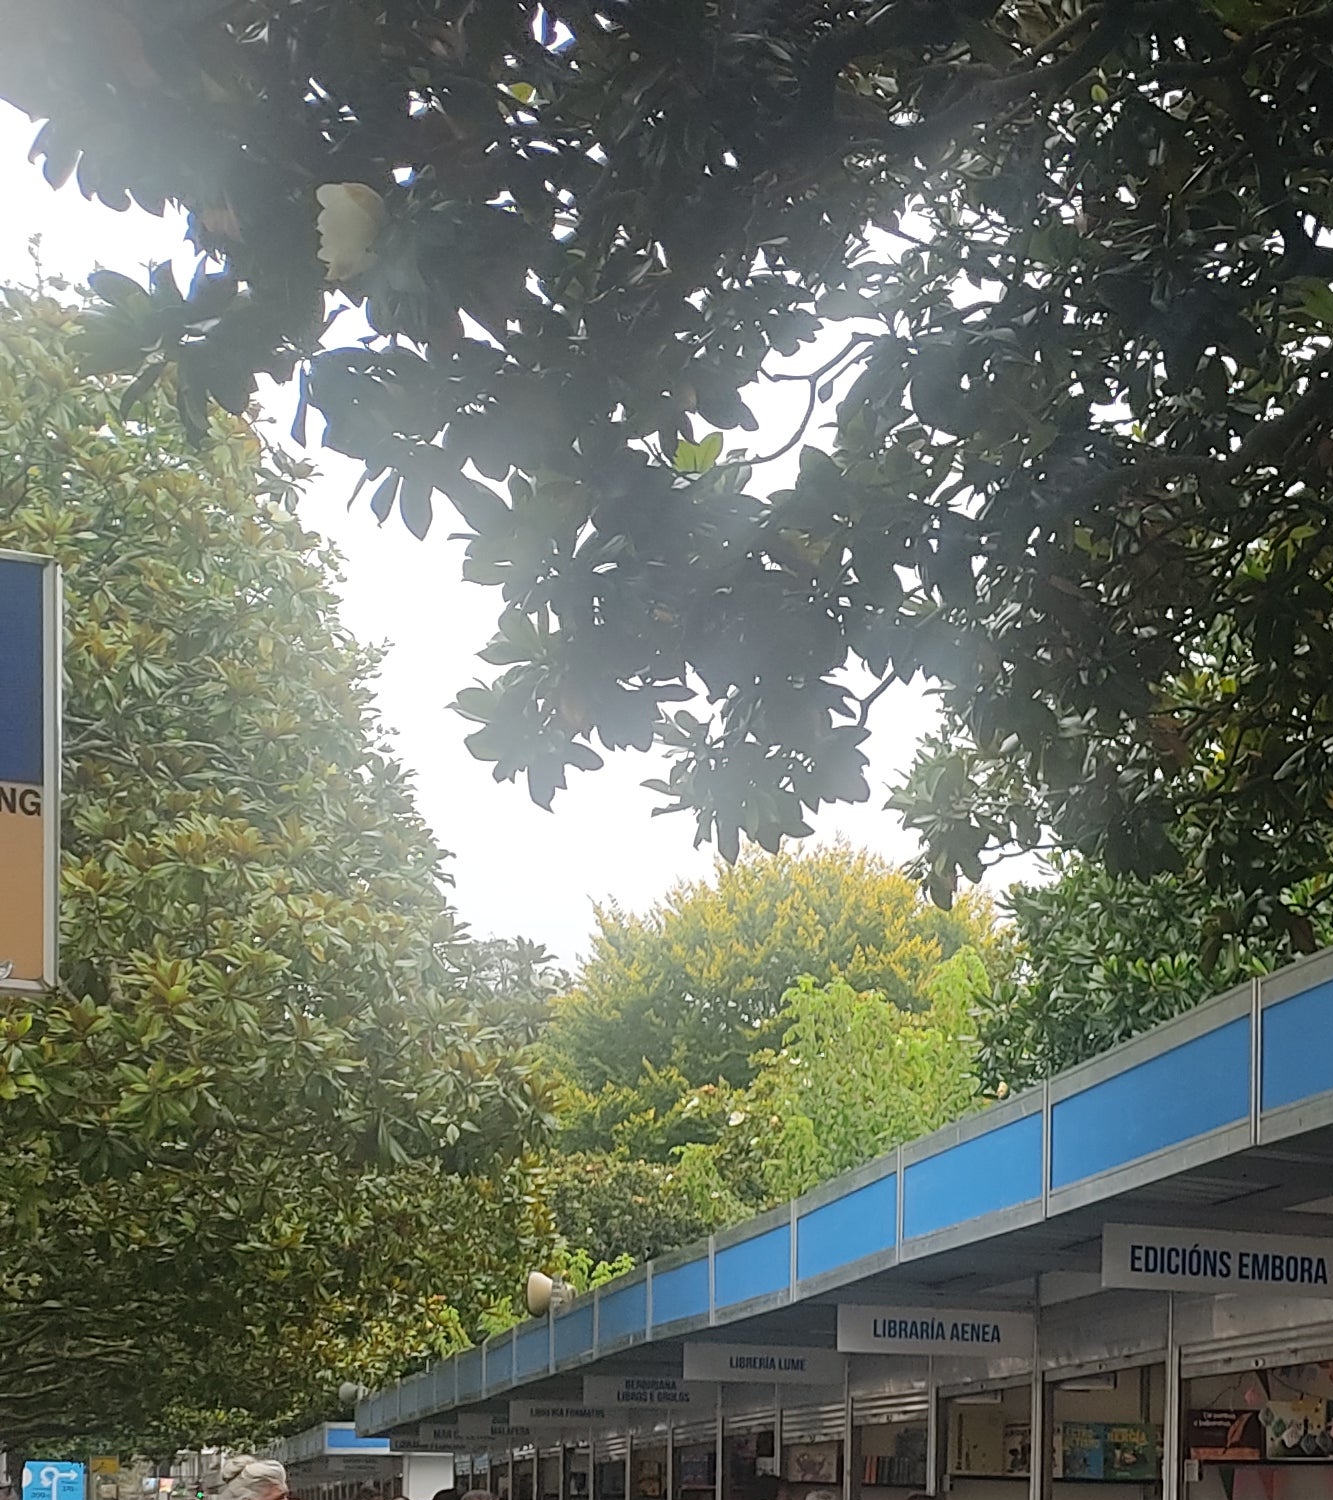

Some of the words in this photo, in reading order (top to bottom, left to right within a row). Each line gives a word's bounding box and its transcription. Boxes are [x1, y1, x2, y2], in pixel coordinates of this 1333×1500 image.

[1130, 1244, 1231, 1278] EDICIÓNS
[1238, 1252, 1327, 1284] EMBORA
[873, 1317, 945, 1341] LIBRARÍA
[950, 1322, 1001, 1344] AENEA
[778, 1357, 809, 1372] LUME
